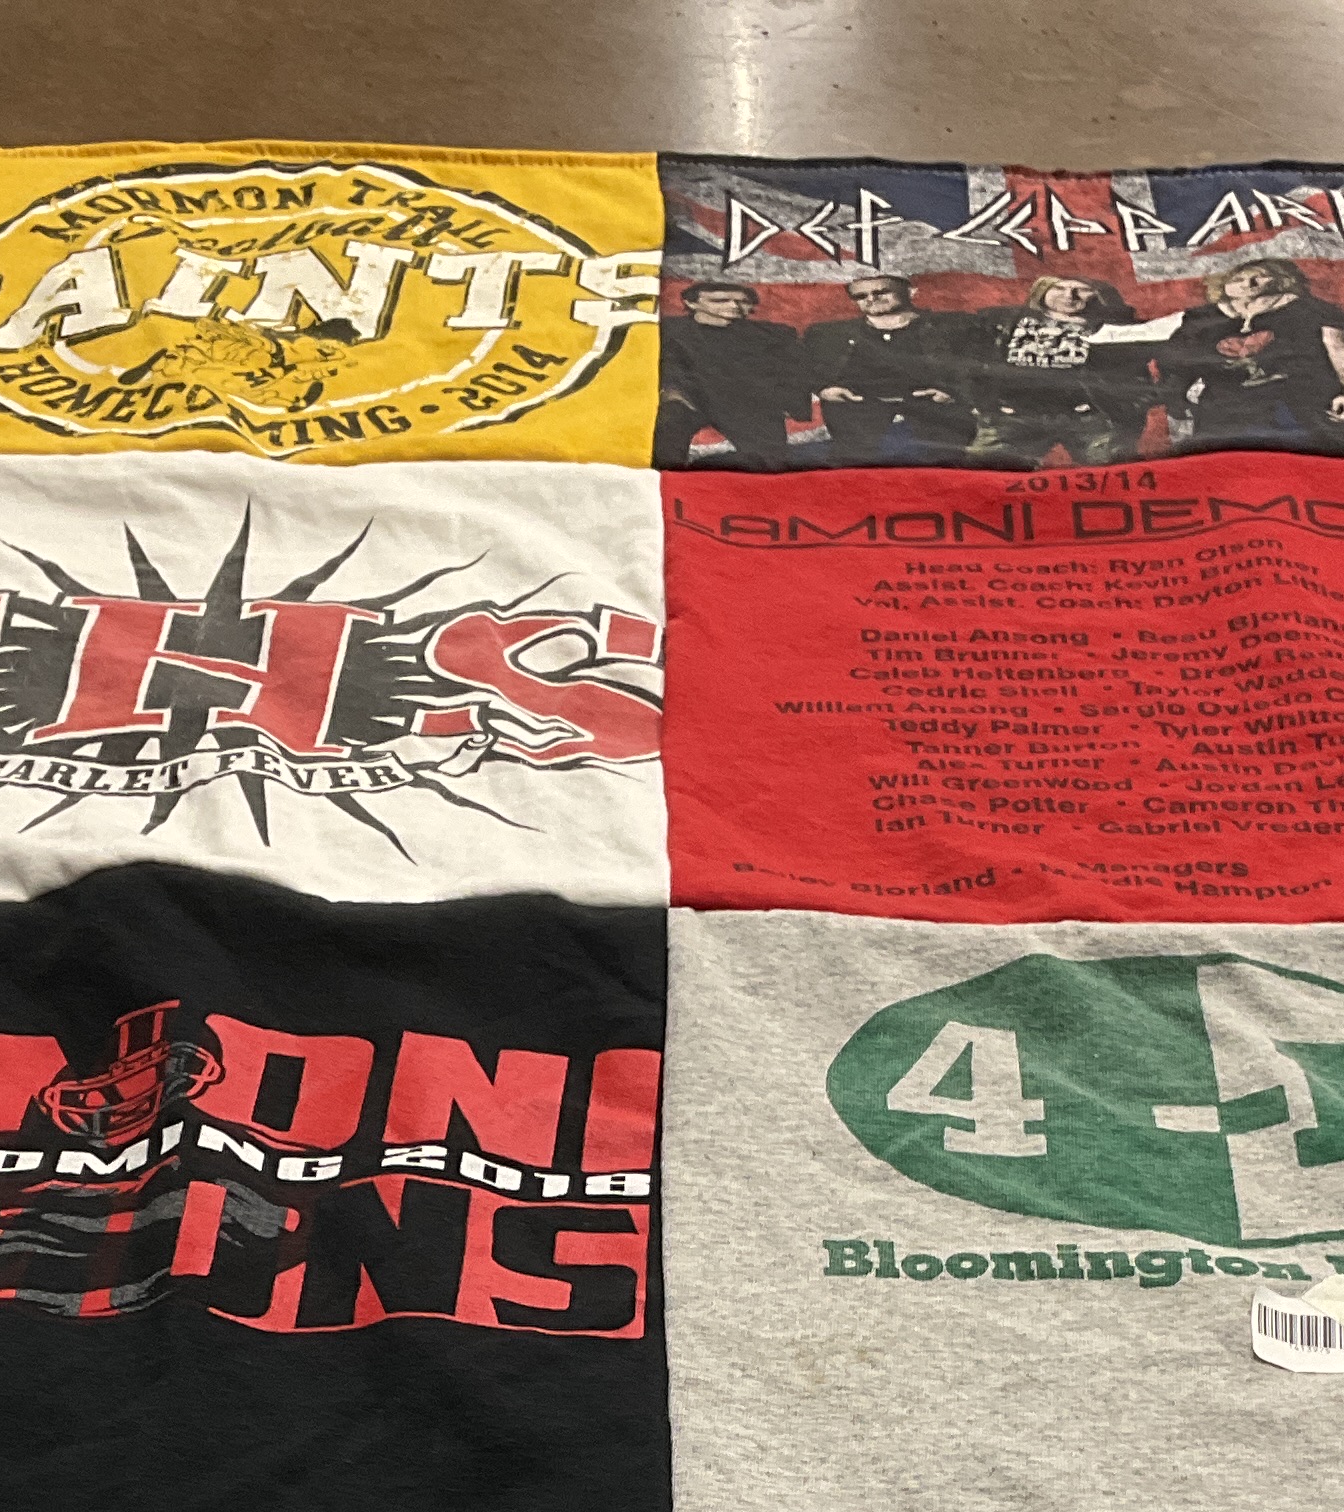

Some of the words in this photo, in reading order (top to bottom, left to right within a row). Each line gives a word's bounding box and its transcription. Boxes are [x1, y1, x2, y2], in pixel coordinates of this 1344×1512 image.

[30, 182, 318, 243] MORMON
[350, 179, 512, 249] TRAIL
[722, 187, 905, 271] DEF
[442, 343, 567, 412] 2014
[1003, 470, 1159, 496] 2013/14
[673, 497, 1035, 544] LAMONI
[988, 577, 1093, 593] Coach:
[1105, 573, 1189, 592] Kevin
[1200, 554, 1320, 581] Brunner
[1109, 556, 1185, 576] Ryan
[1155, 576, 1263, 609] Dayton
[861, 628, 958, 644] Daniel
[969, 628, 1090, 646] Ansong
[1137, 626, 1218, 645] Beau
[849, 666, 942, 681] Caleb
[1180, 654, 1263, 682] Drew
[866, 648, 924, 662] Tim
[935, 647, 1059, 663] Brunner
[1111, 645, 1229, 666] Jeremy
[882, 682, 988, 699] Cedric
[1128, 680, 1226, 699] Taylor
[775, 699, 895, 715] William
[906, 702, 1029, 718] Ansong
[1197, 690, 1313, 717] Oviedo
[882, 718, 979, 739] Teddy
[990, 718, 1105, 737] Palmer
[1154, 719, 1234, 740] Tyler
[905, 739, 1016, 756] Tanner
[1191, 738, 1298, 757] Austin
[211, 750, 404, 794] FEVER
[998, 756, 1106, 771] Turner
[1156, 756, 1263, 776] Austin
[868, 773, 931, 790] Will
[941, 774, 1134, 793] Greenwood
[988, 796, 1089, 815] Potter
[1143, 796, 1298, 815] Cameron
[875, 813, 927, 833] Ian
[1098, 818, 1222, 837] Gabriel
[1174, 875, 1334, 900] Hampton
[380, 1144, 651, 1198] 2018
[822, 1238, 1313, 1288] Bloomington
